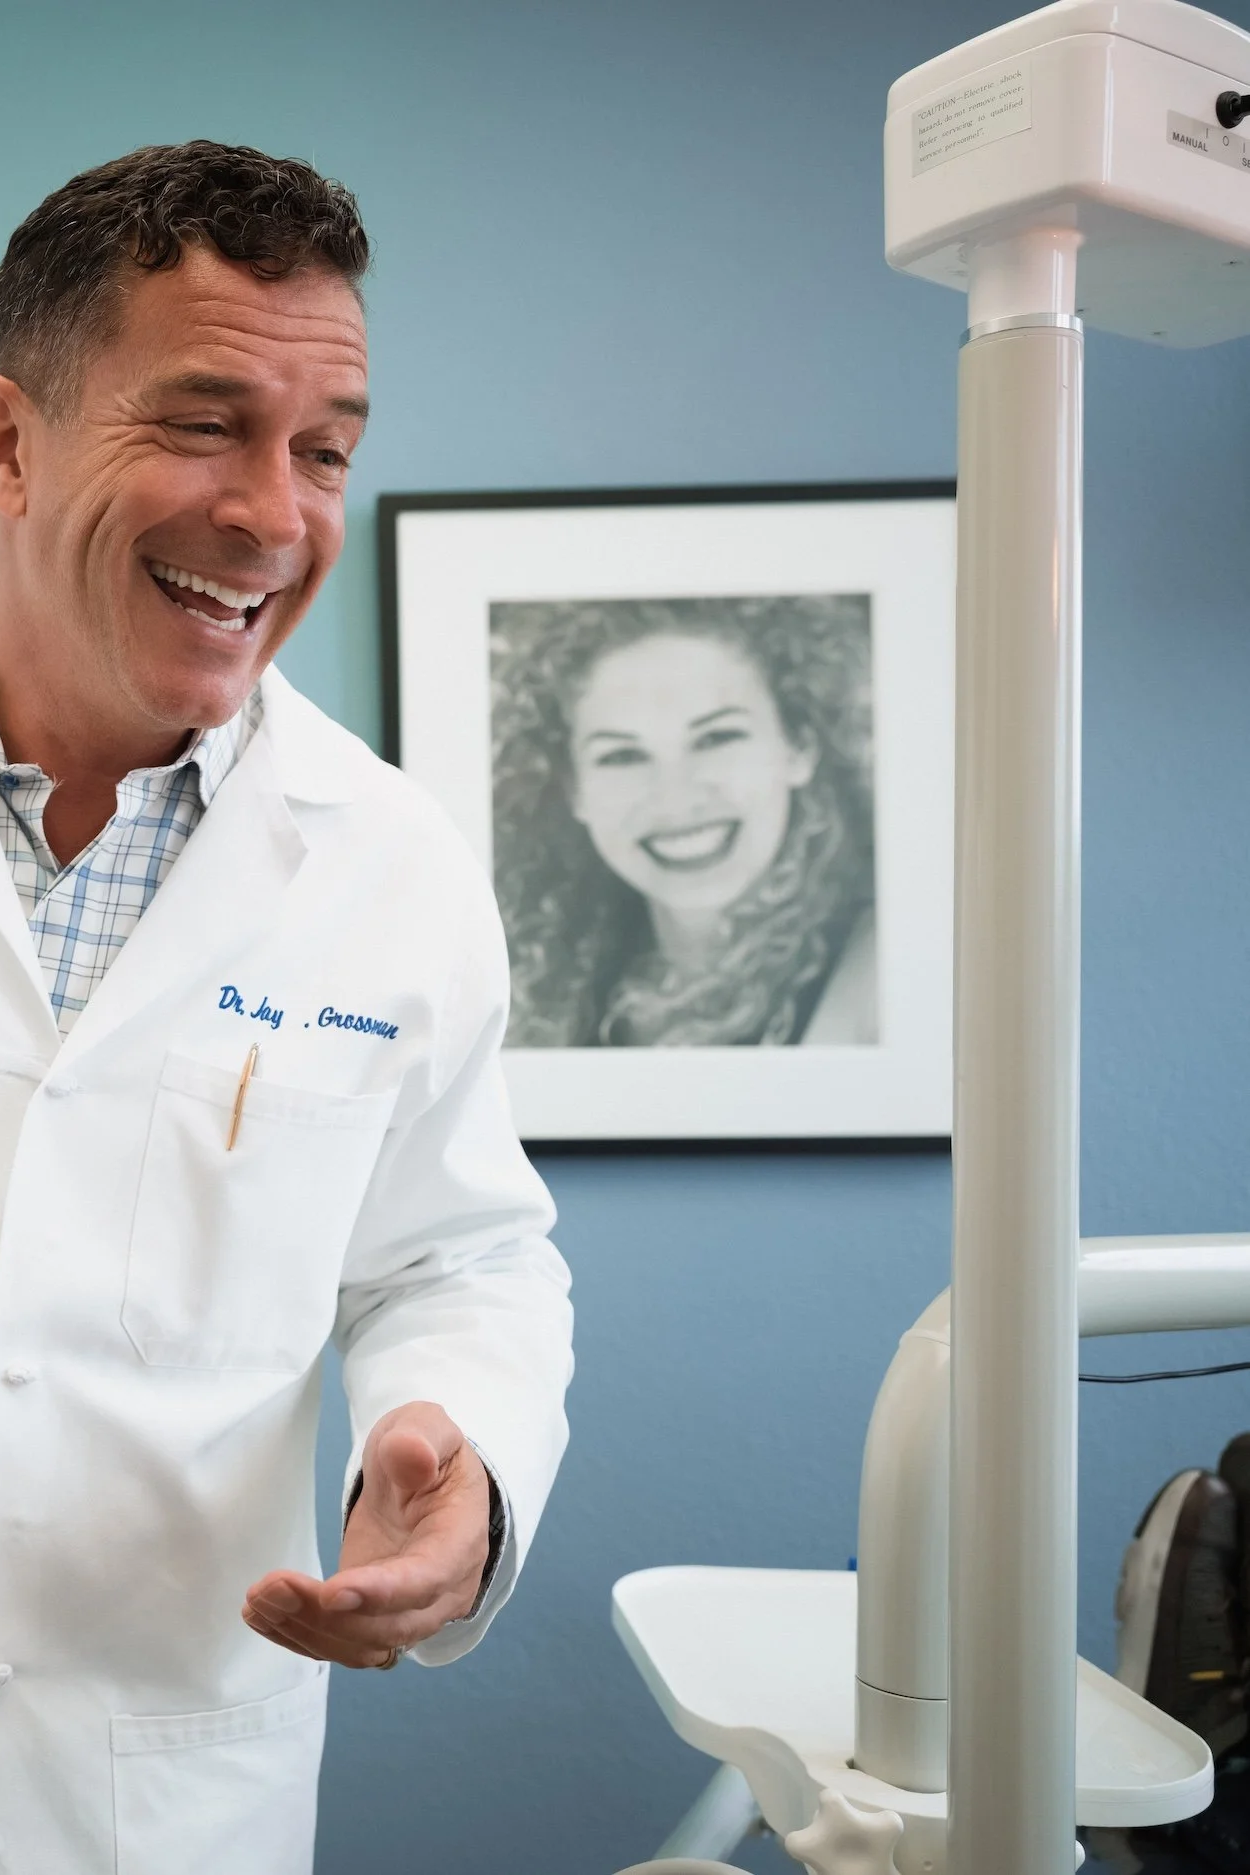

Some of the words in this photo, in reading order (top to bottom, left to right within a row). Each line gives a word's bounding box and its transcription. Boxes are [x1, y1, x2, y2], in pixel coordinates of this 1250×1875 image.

[1000, 69, 1022, 84] shock
[944, 114, 953, 123] do
[954, 108, 966, 118] not
[969, 96, 996, 112] remove
[990, 97, 1023, 118] qualified
[1172, 131, 1209, 153] MANUAL
[250, 996, 284, 1030] Jay
[318, 1006, 399, 1040] Grossman
